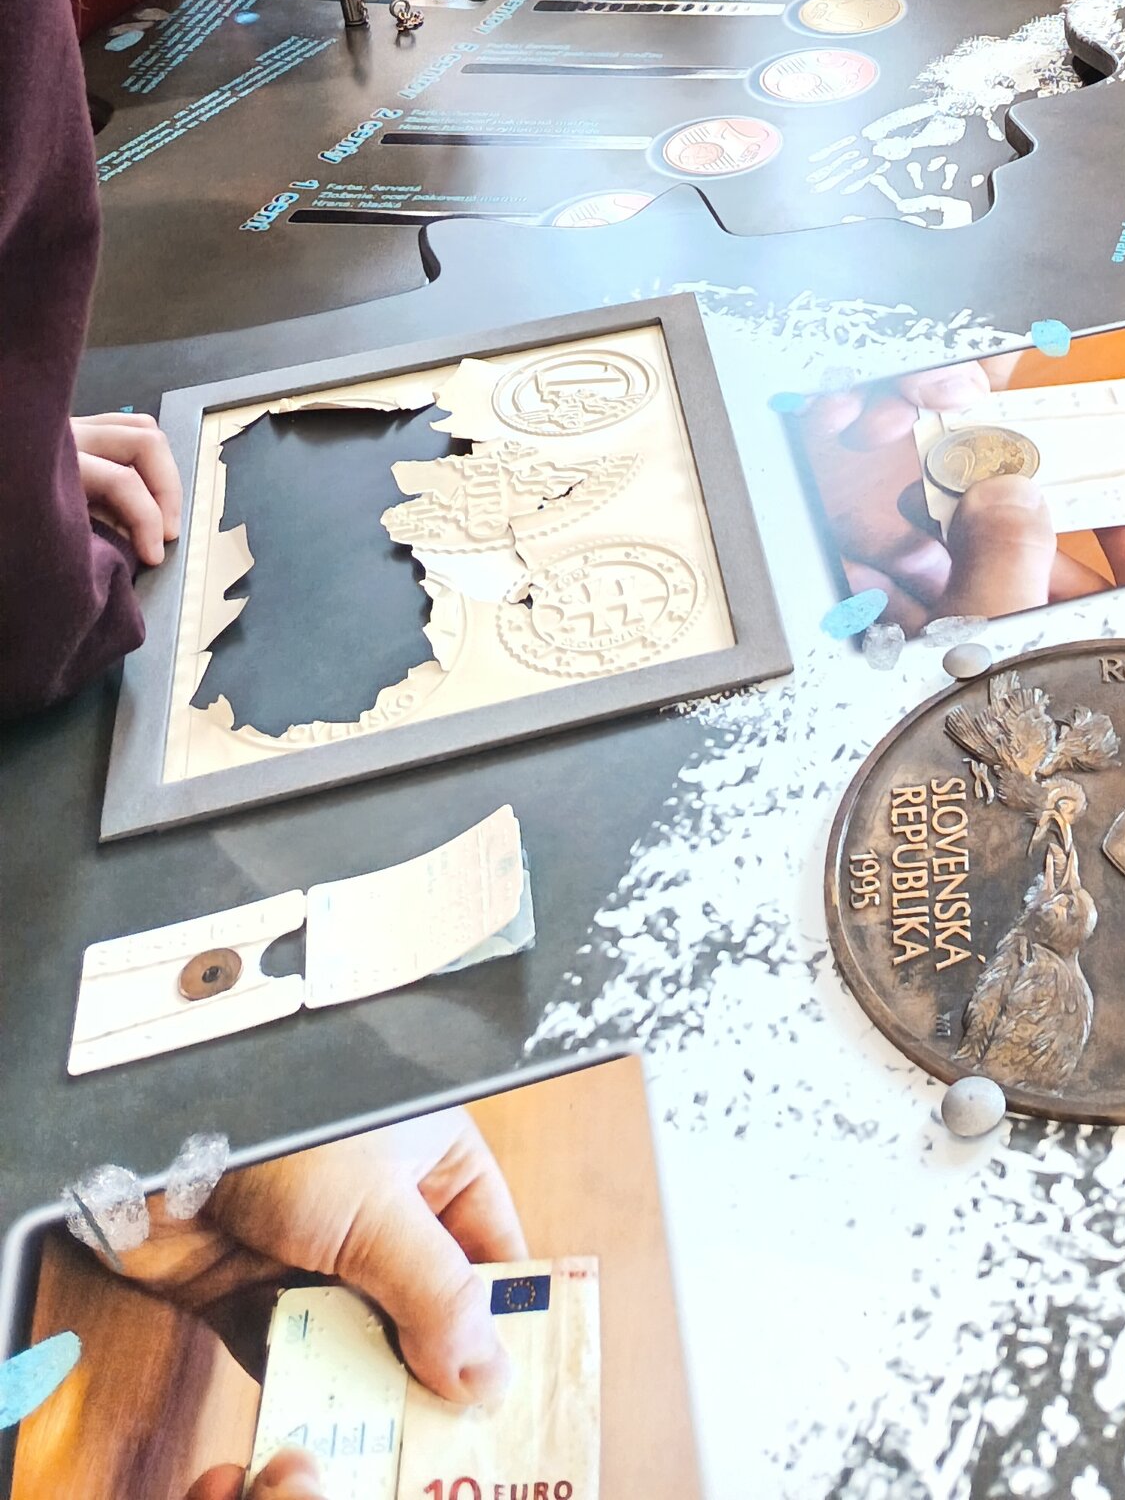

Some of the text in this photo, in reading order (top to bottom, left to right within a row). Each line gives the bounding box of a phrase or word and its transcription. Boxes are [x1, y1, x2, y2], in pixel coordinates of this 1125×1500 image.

[397, 52, 462, 100] centov
[317, 107, 404, 163] 2 centy
[239, 179, 320, 232] 1 cent
[848, 848, 881, 910] 1995
[890, 785, 931, 966] REPUBLIKA
[930, 776, 987, 972] SLOVENSKÁ
[494, 1480, 573, 1500] EURO
